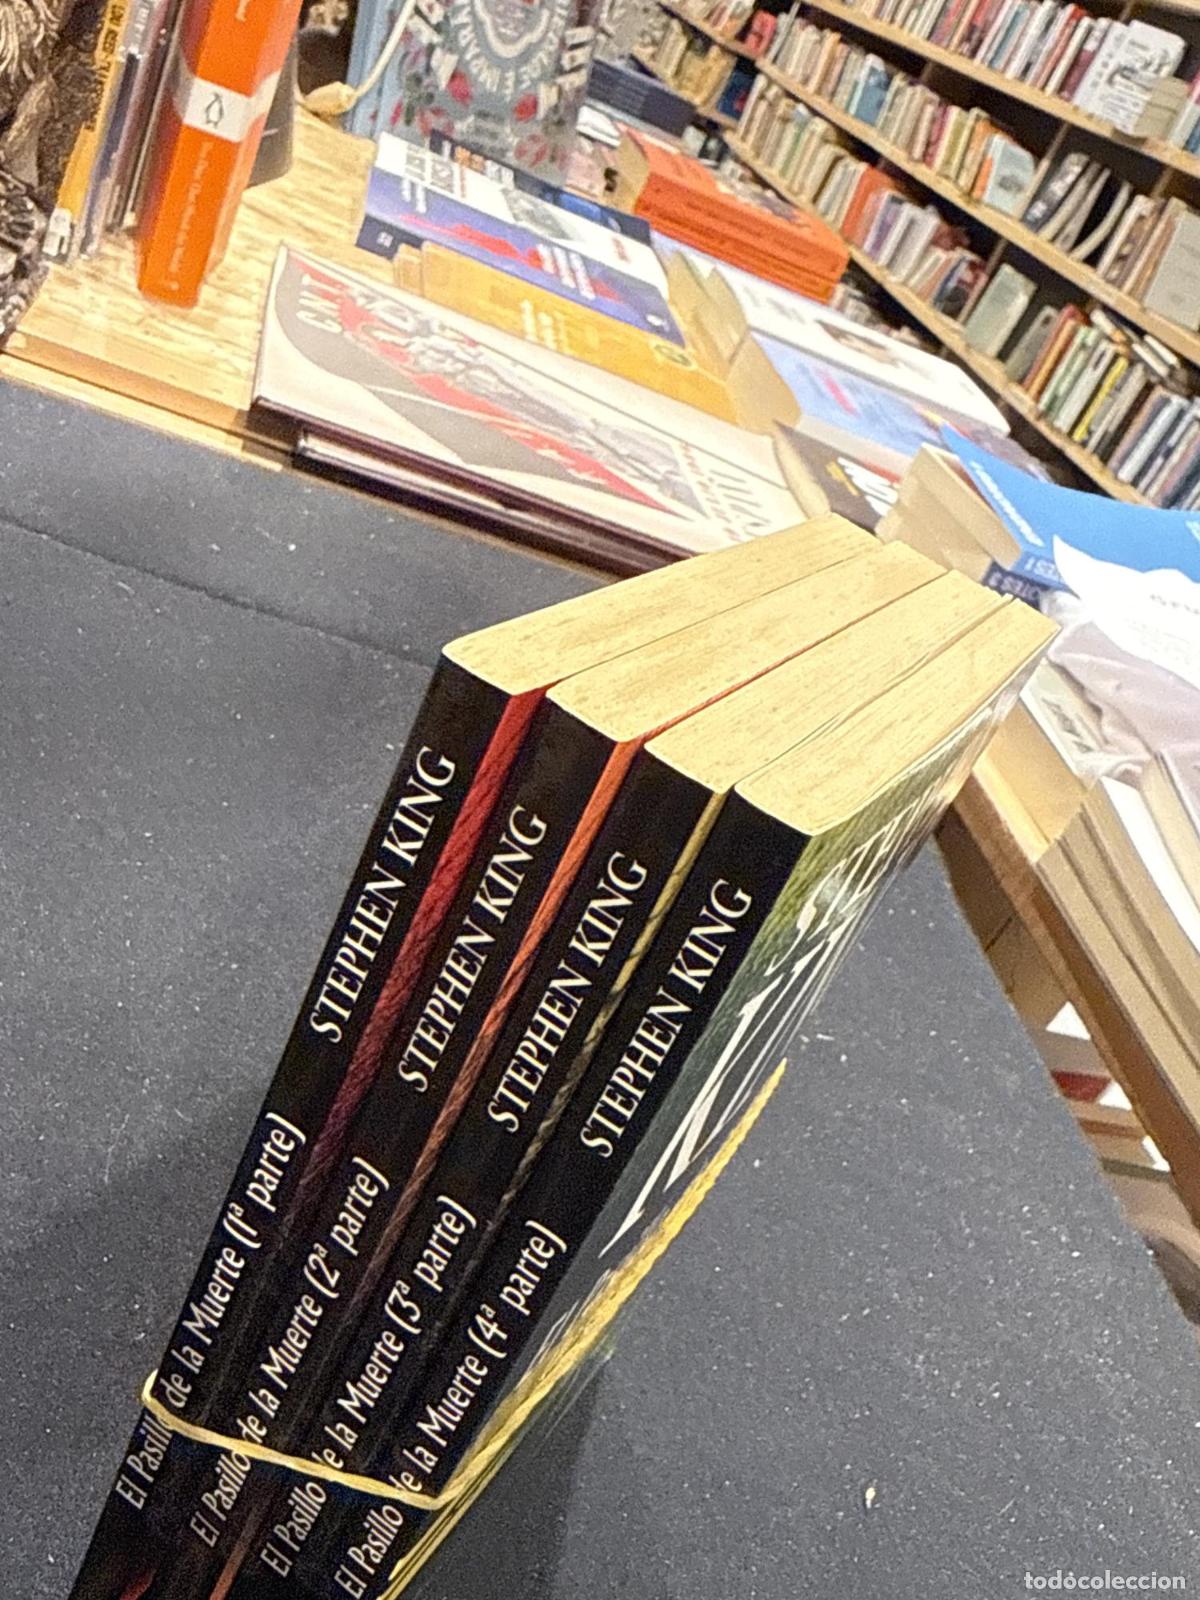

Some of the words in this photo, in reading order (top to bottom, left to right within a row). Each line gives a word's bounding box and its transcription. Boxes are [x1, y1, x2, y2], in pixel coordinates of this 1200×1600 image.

[310, 862, 407, 1044] STEPHEN
[381, 745, 457, 867] KING
[398, 919, 496, 1093] STEPHEN
[474, 804, 548, 924] KING
[487, 963, 593, 1133] STEPHEN
[568, 850, 648, 968] KING
[579, 986, 692, 1158] STEPHEN
[669, 878, 752, 994] KING
[245, 1112, 307, 1213] parte)
[330, 1156, 390, 1256] parte)
[413, 1195, 477, 1292] parte)
[499, 1220, 567, 1316] parte)
[182, 1247, 245, 1345] Muerte
[171, 1345, 205, 1374] la
[260, 1293, 323, 1390] Muerte
[160, 1373, 192, 1408] de
[248, 1388, 281, 1418] la
[337, 1331, 404, 1424] Muerte
[416, 1354, 488, 1447] Muerte
[126, 1413, 174, 1483] Pasill
[311, 1448, 344, 1469] e
[324, 1422, 359, 1451] la
[402, 1445, 439, 1474] la
[115, 1474, 148, 1510] El
[201, 1450, 251, 1521] Pasillo
[273, 1481, 327, 1552] Pasillo
[189, 1511, 220, 1548] El
[260, 1542, 293, 1577] El
[347, 1505, 404, 1575] Pasillo
[334, 1564, 367, 1600] El
